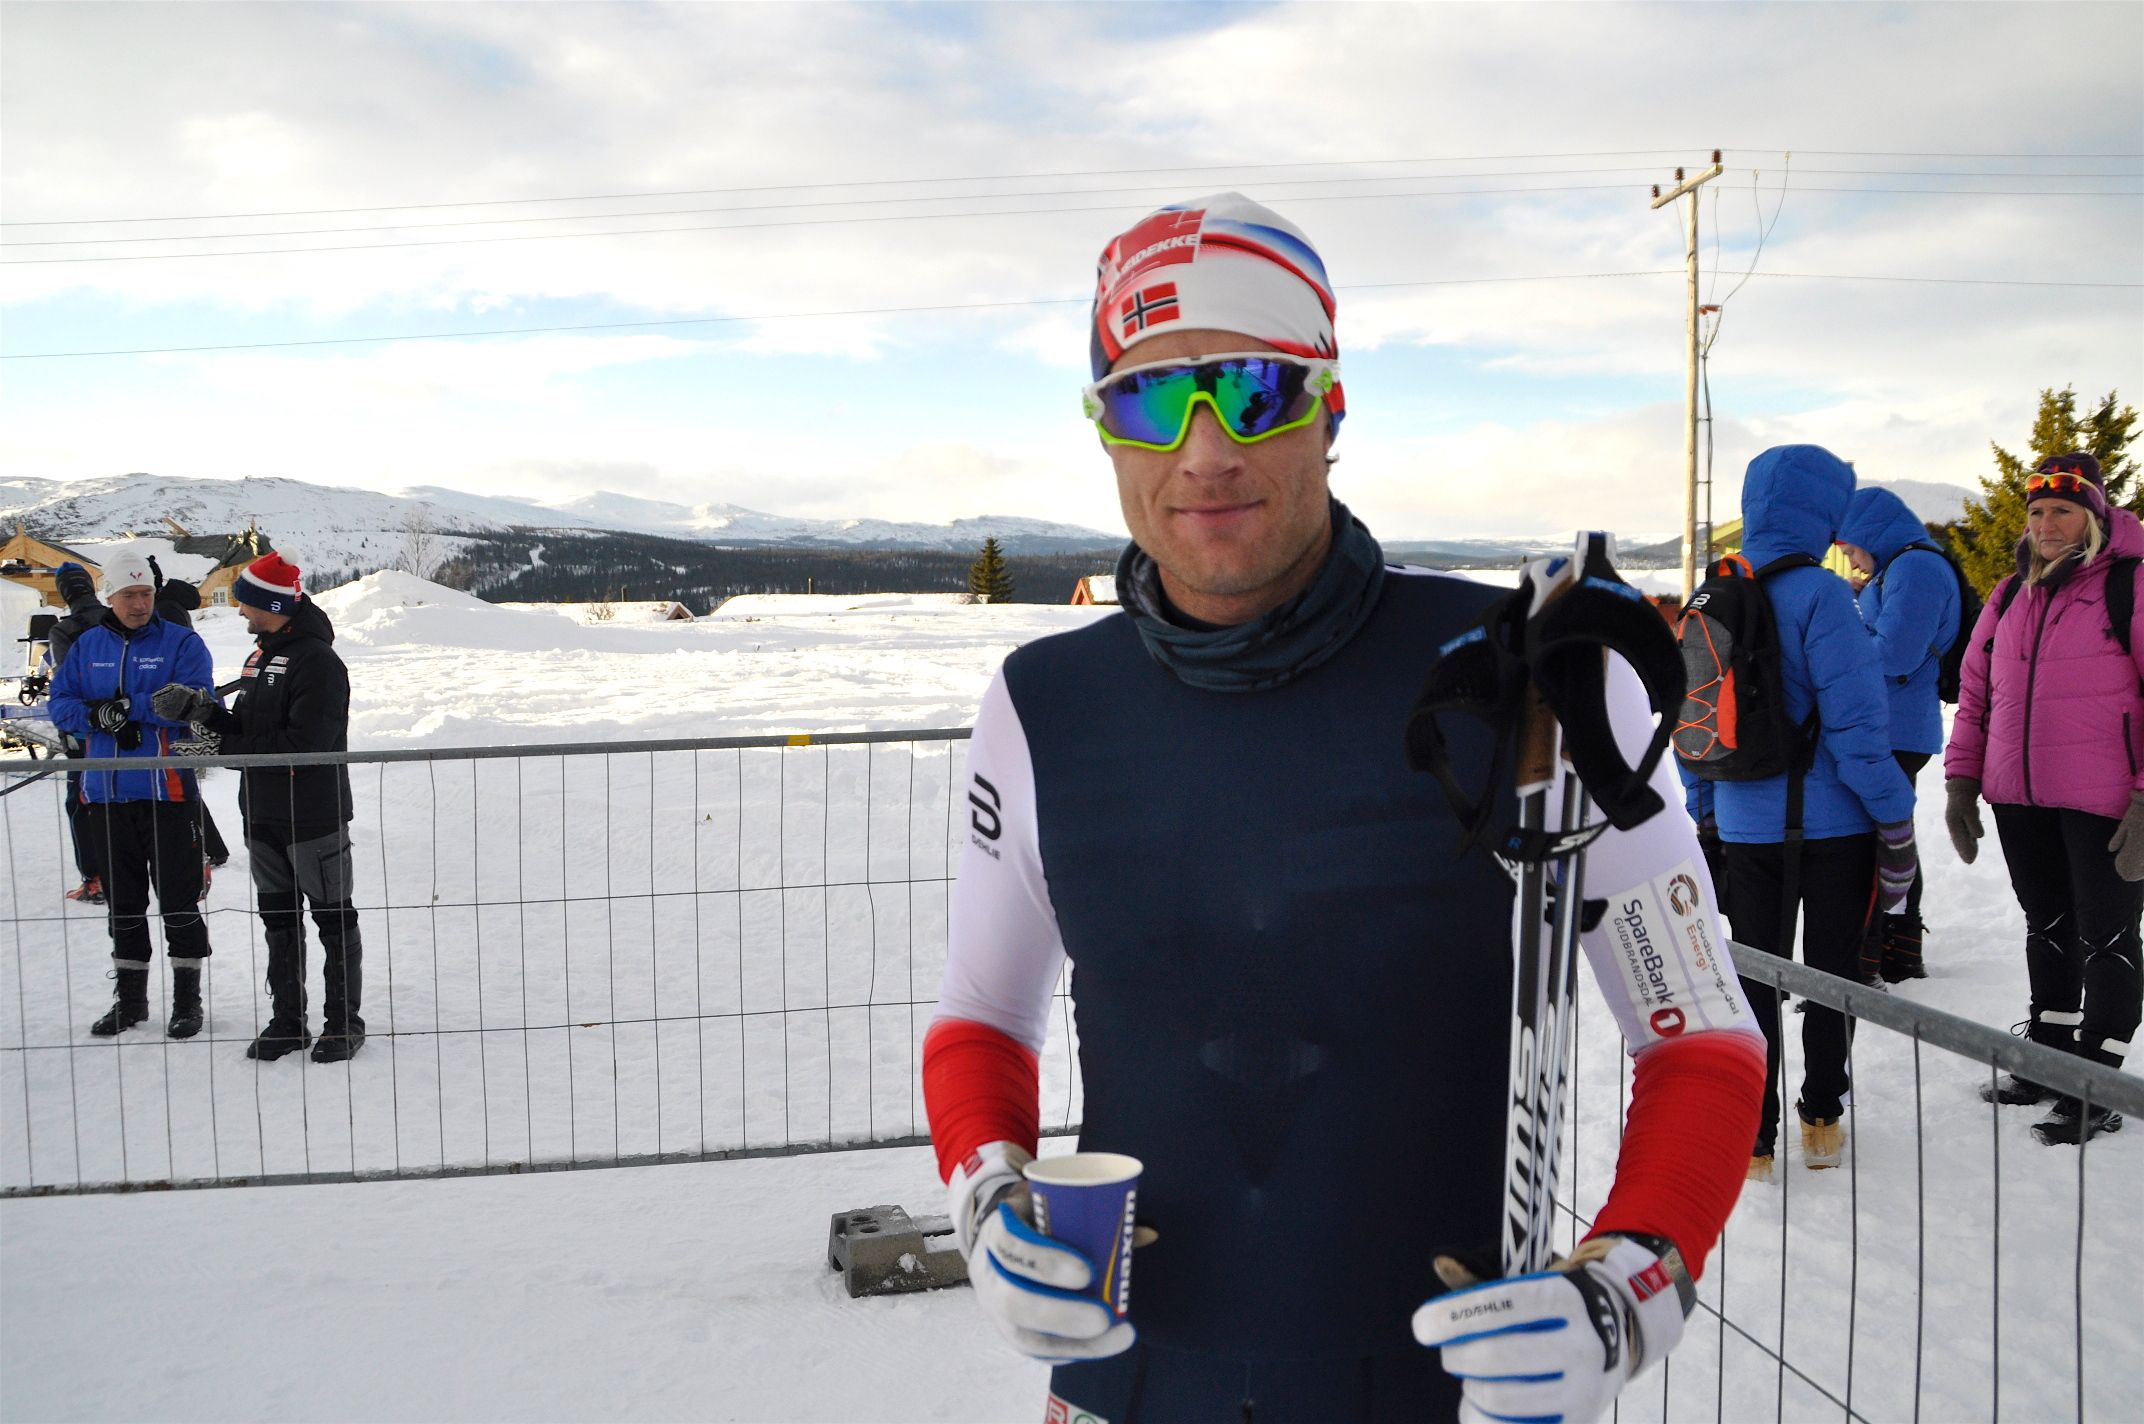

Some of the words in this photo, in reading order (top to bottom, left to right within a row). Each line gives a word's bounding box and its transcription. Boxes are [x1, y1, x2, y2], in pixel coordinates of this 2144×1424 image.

[1624, 899, 1675, 1005] SpareBank
[1686, 924, 1710, 972] Energi
[1696, 918, 1740, 1015] Gudbranddal
[1117, 1189, 1137, 1313] maxim
